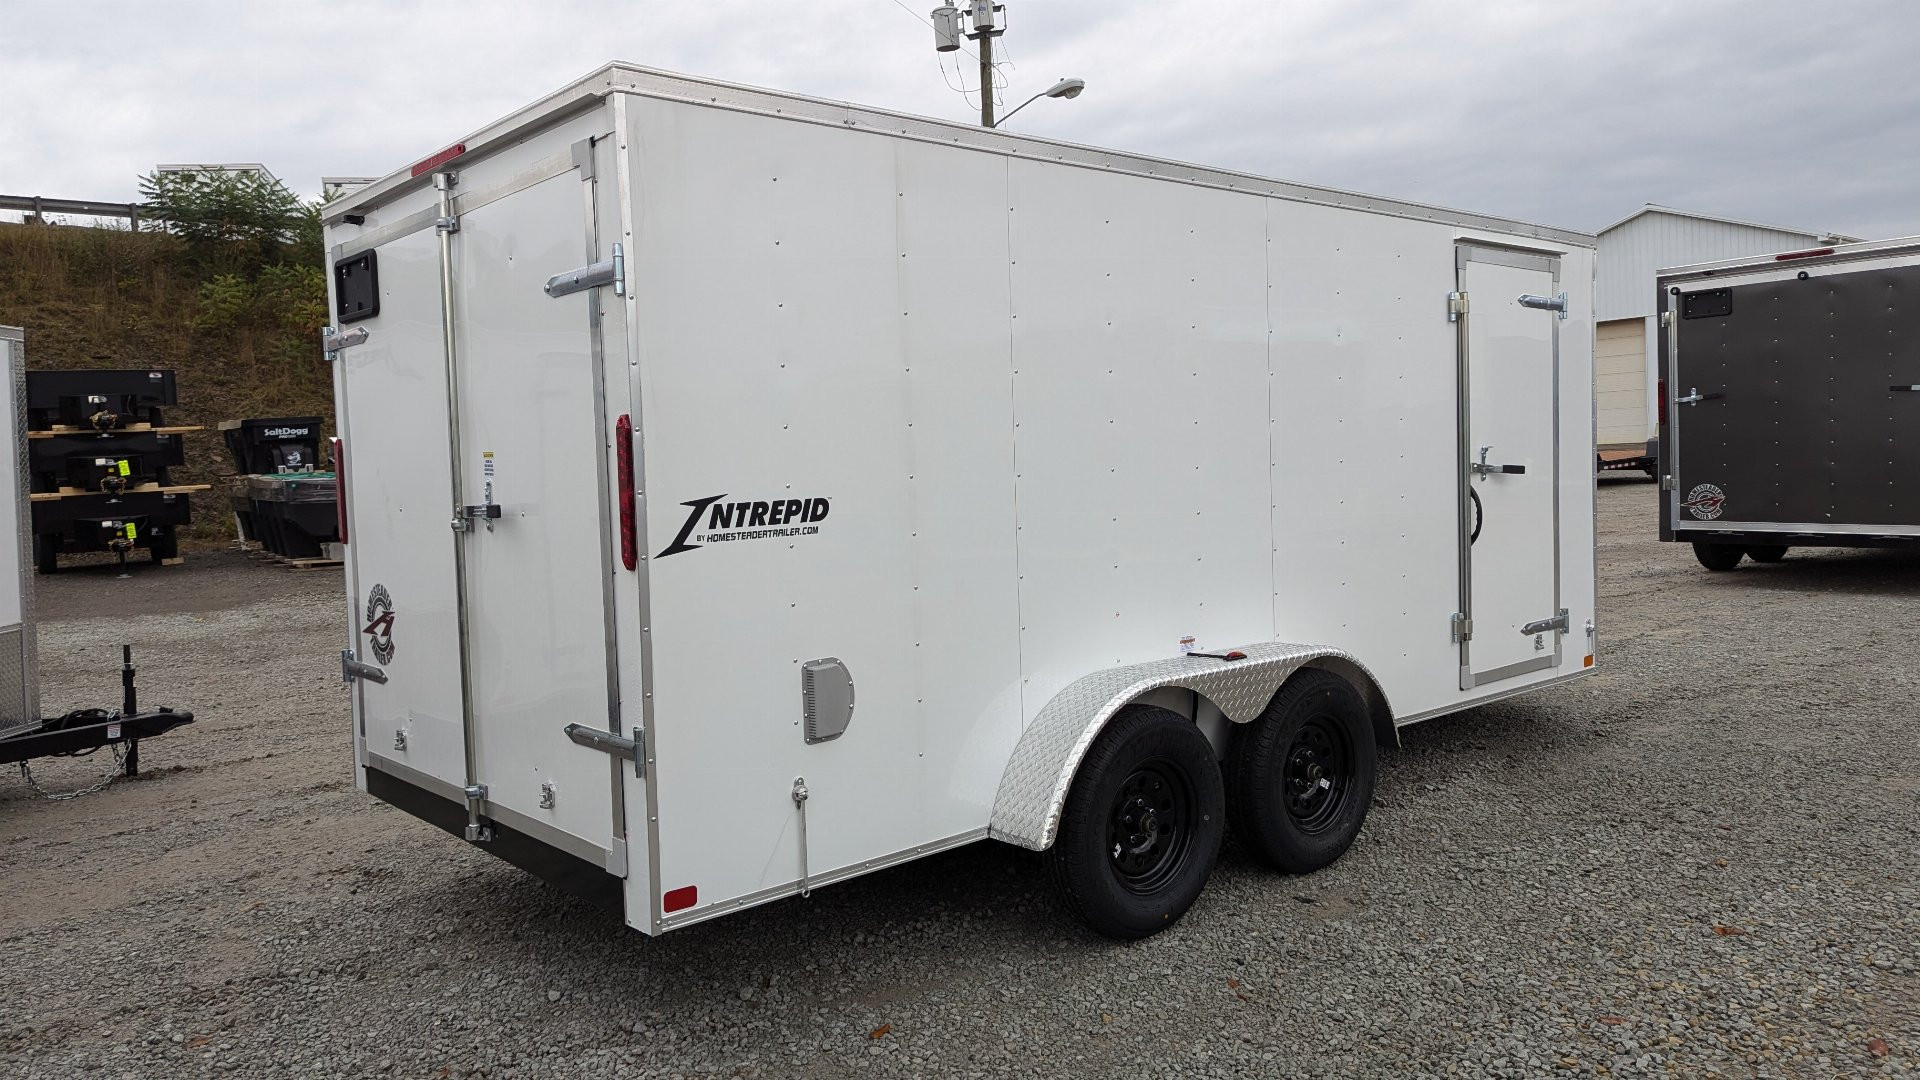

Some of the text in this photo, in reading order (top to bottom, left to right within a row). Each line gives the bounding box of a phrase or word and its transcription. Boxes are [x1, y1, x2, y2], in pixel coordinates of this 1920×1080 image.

[264, 427, 309, 436] SaltDogg
[653, 493, 830, 559] INTREPID
[696, 534, 706, 542] BY
